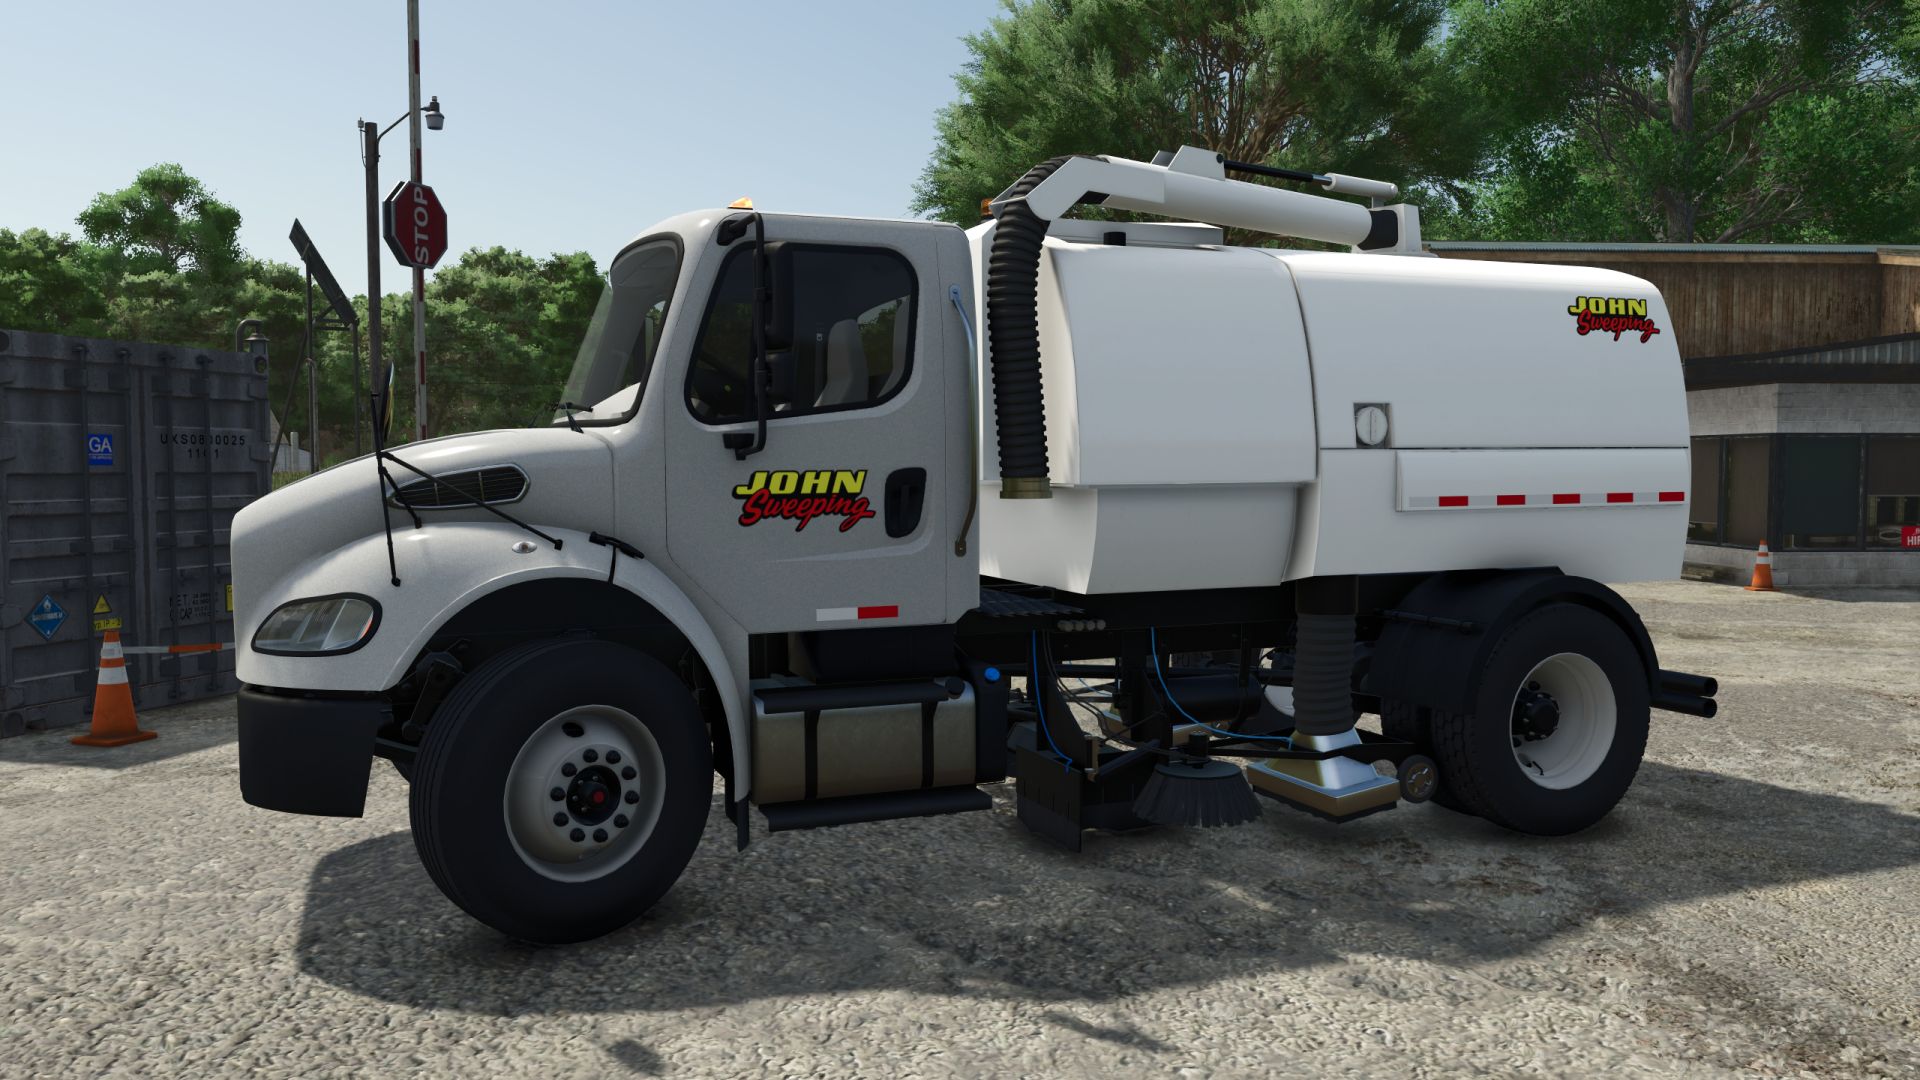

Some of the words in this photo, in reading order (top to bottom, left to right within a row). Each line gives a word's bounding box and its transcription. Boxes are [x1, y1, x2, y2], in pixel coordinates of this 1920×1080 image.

[414, 186, 429, 264] STOP
[1568, 296, 1648, 316] JOHN
[1577, 308, 1660, 343] Sweeping
[88, 436, 113, 453] GA
[732, 470, 867, 498] JOHN
[738, 488, 876, 532] Sweeping
